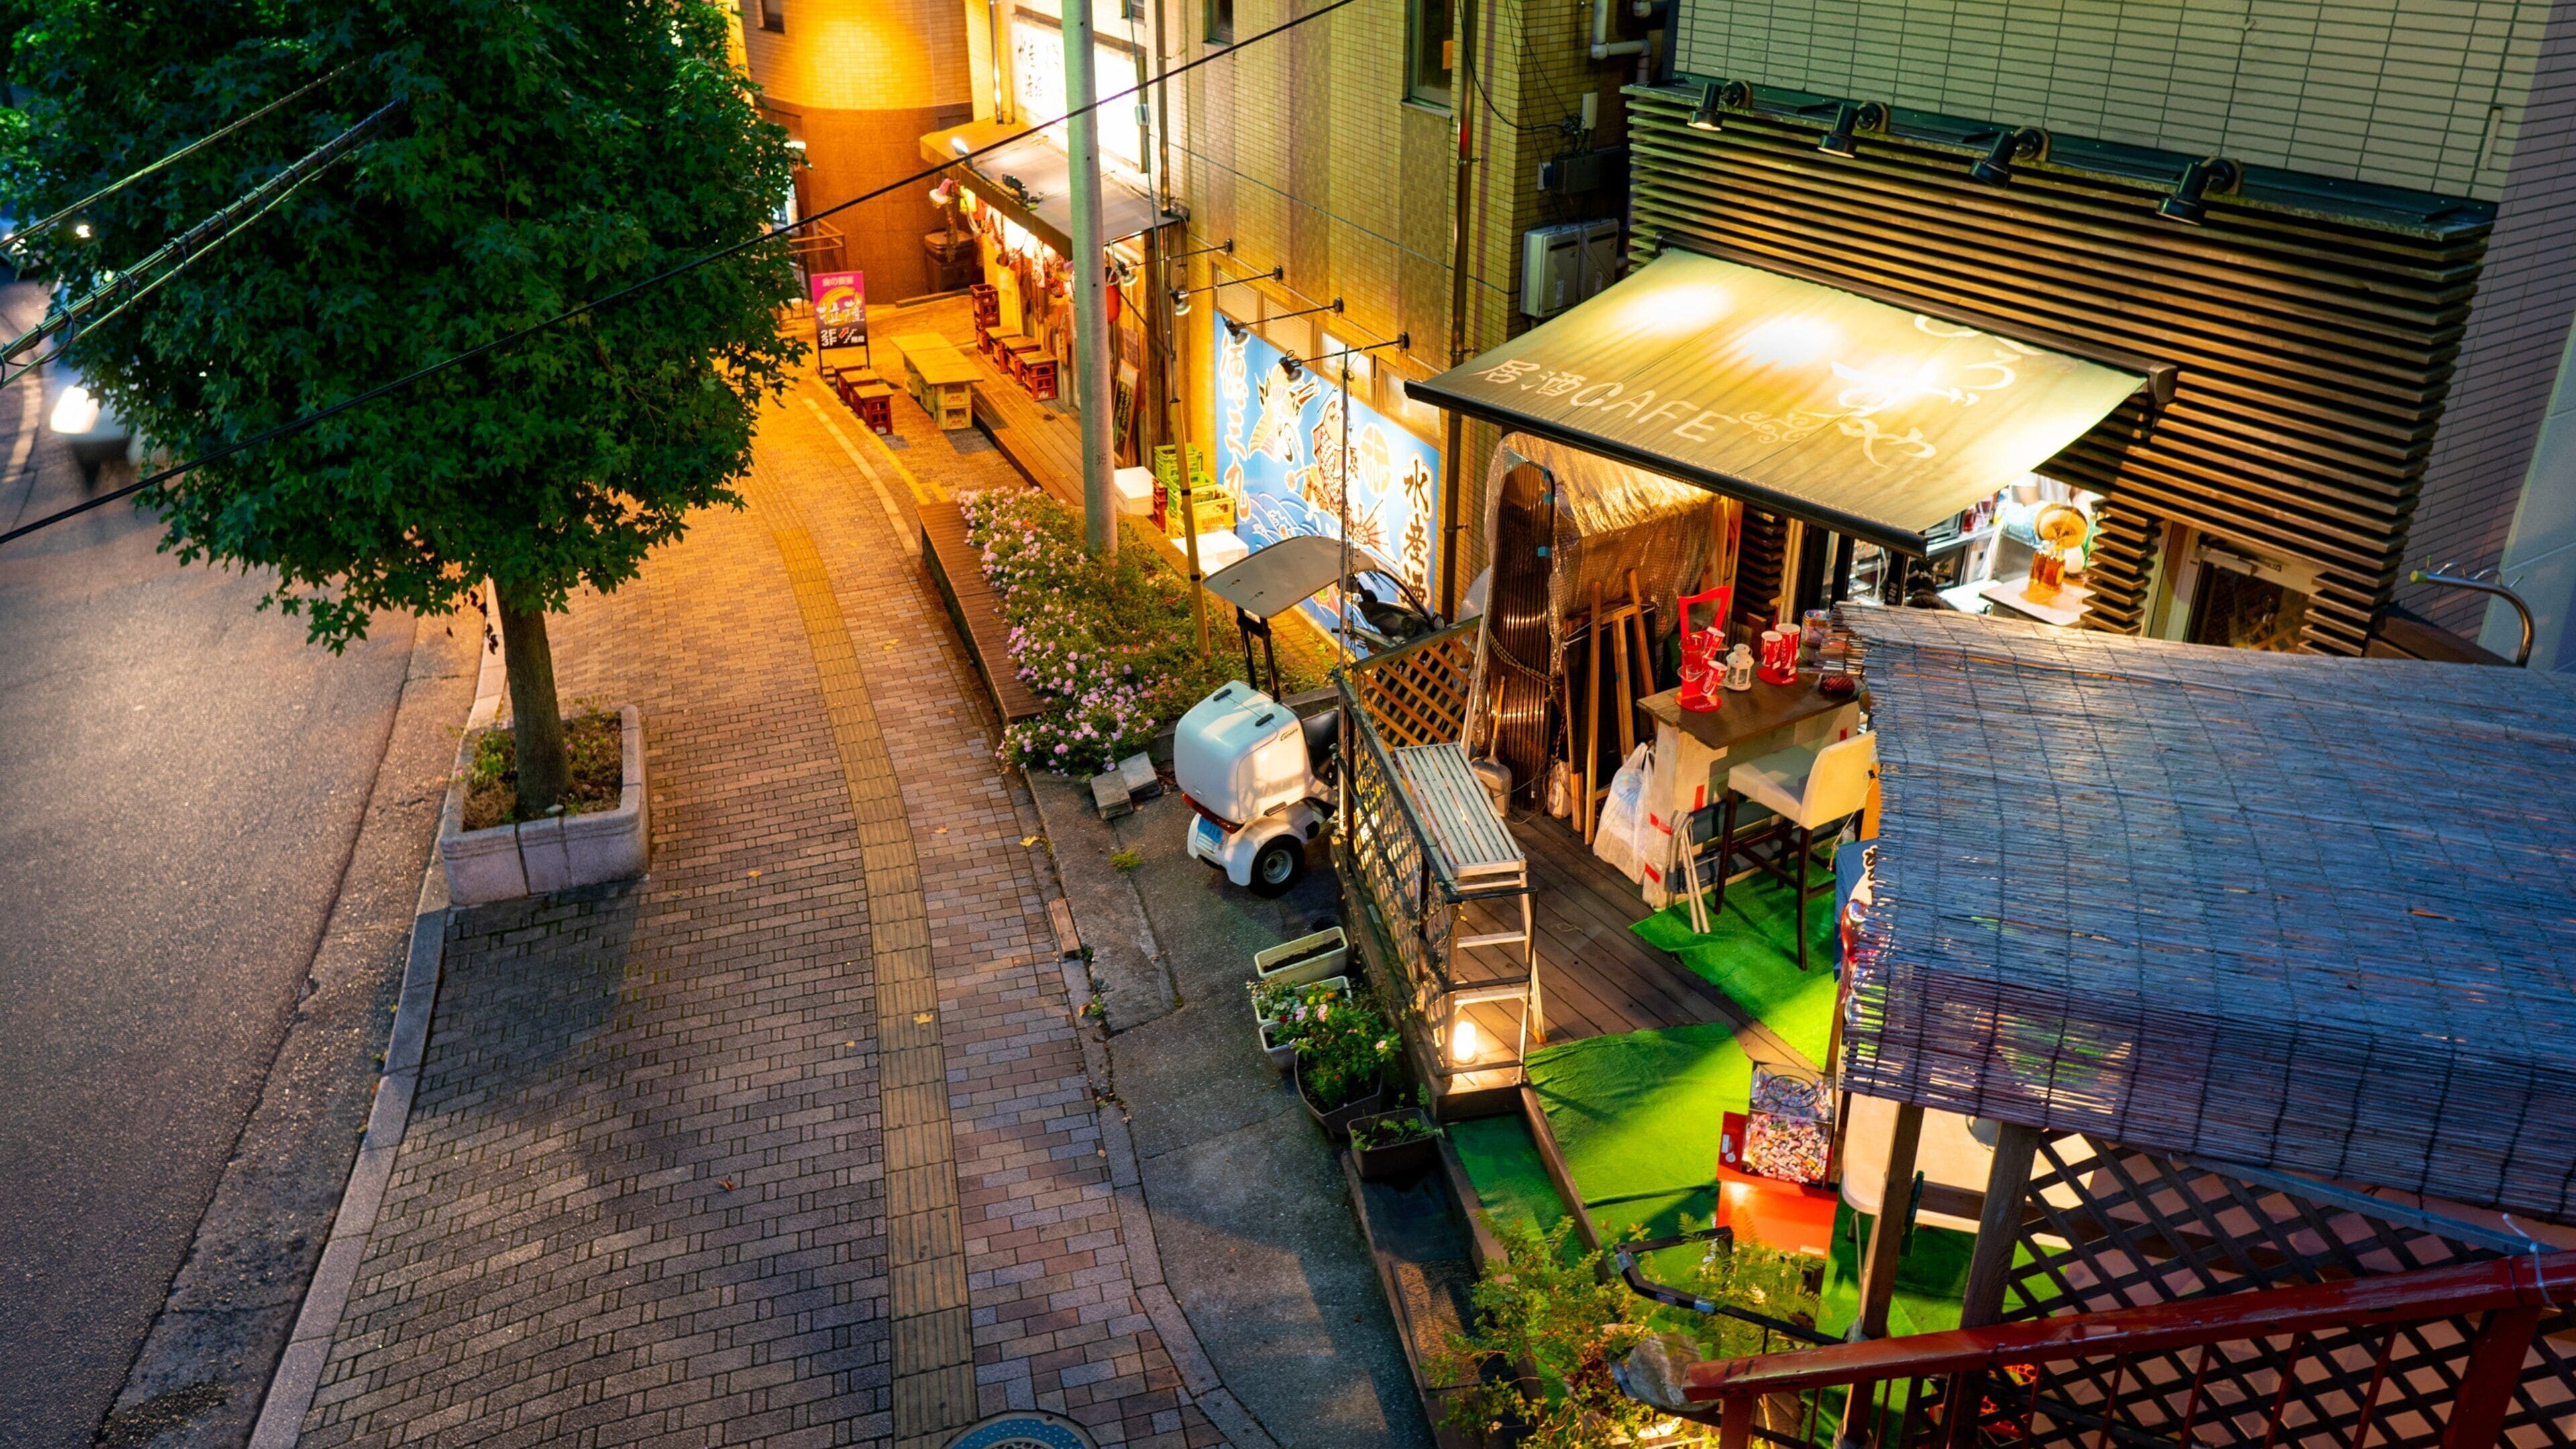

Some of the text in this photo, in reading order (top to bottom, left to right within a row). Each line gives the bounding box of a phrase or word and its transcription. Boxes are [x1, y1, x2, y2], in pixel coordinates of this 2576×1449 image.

[820, 329, 837, 338] 2F
[821, 337, 837, 346] 3F
[1469, 359, 1740, 443] 居酒CAFE
